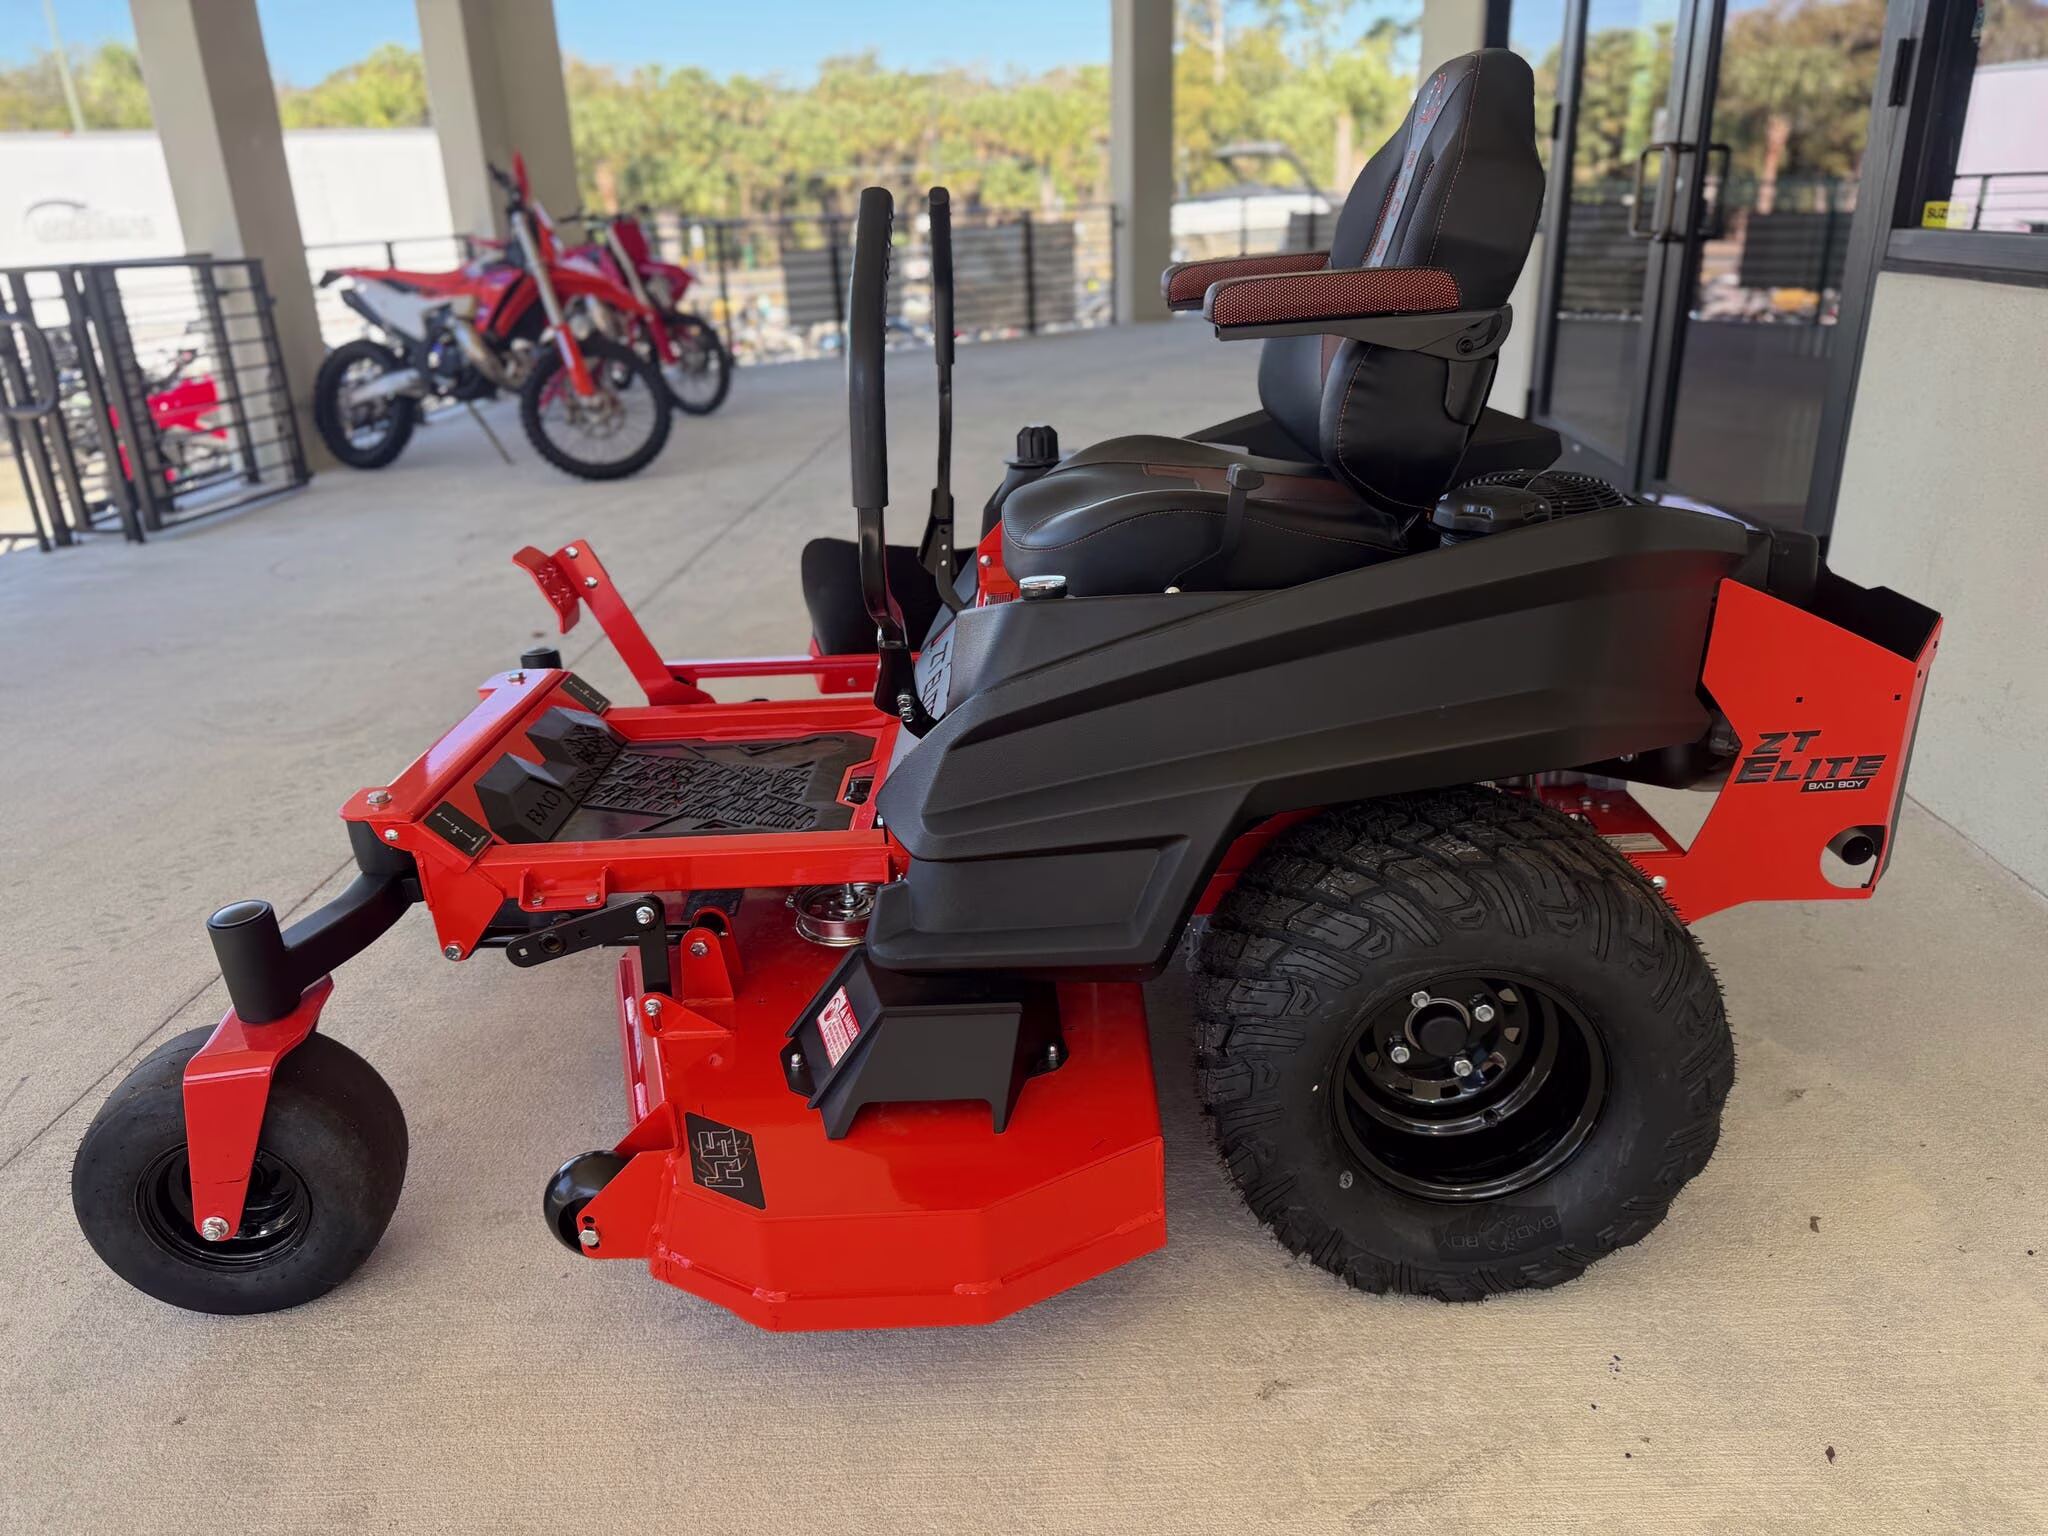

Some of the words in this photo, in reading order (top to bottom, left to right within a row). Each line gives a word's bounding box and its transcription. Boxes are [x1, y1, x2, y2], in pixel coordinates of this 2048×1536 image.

[1752, 730, 1822, 755] ZT
[1734, 754, 1887, 784] ELITE
[1808, 782, 1834, 790] BAD
[1838, 780, 1864, 788] BOY
[525, 790, 561, 826] BAD
[698, 1128, 744, 1188] 54
[1515, 1215, 1558, 1239] BAD
